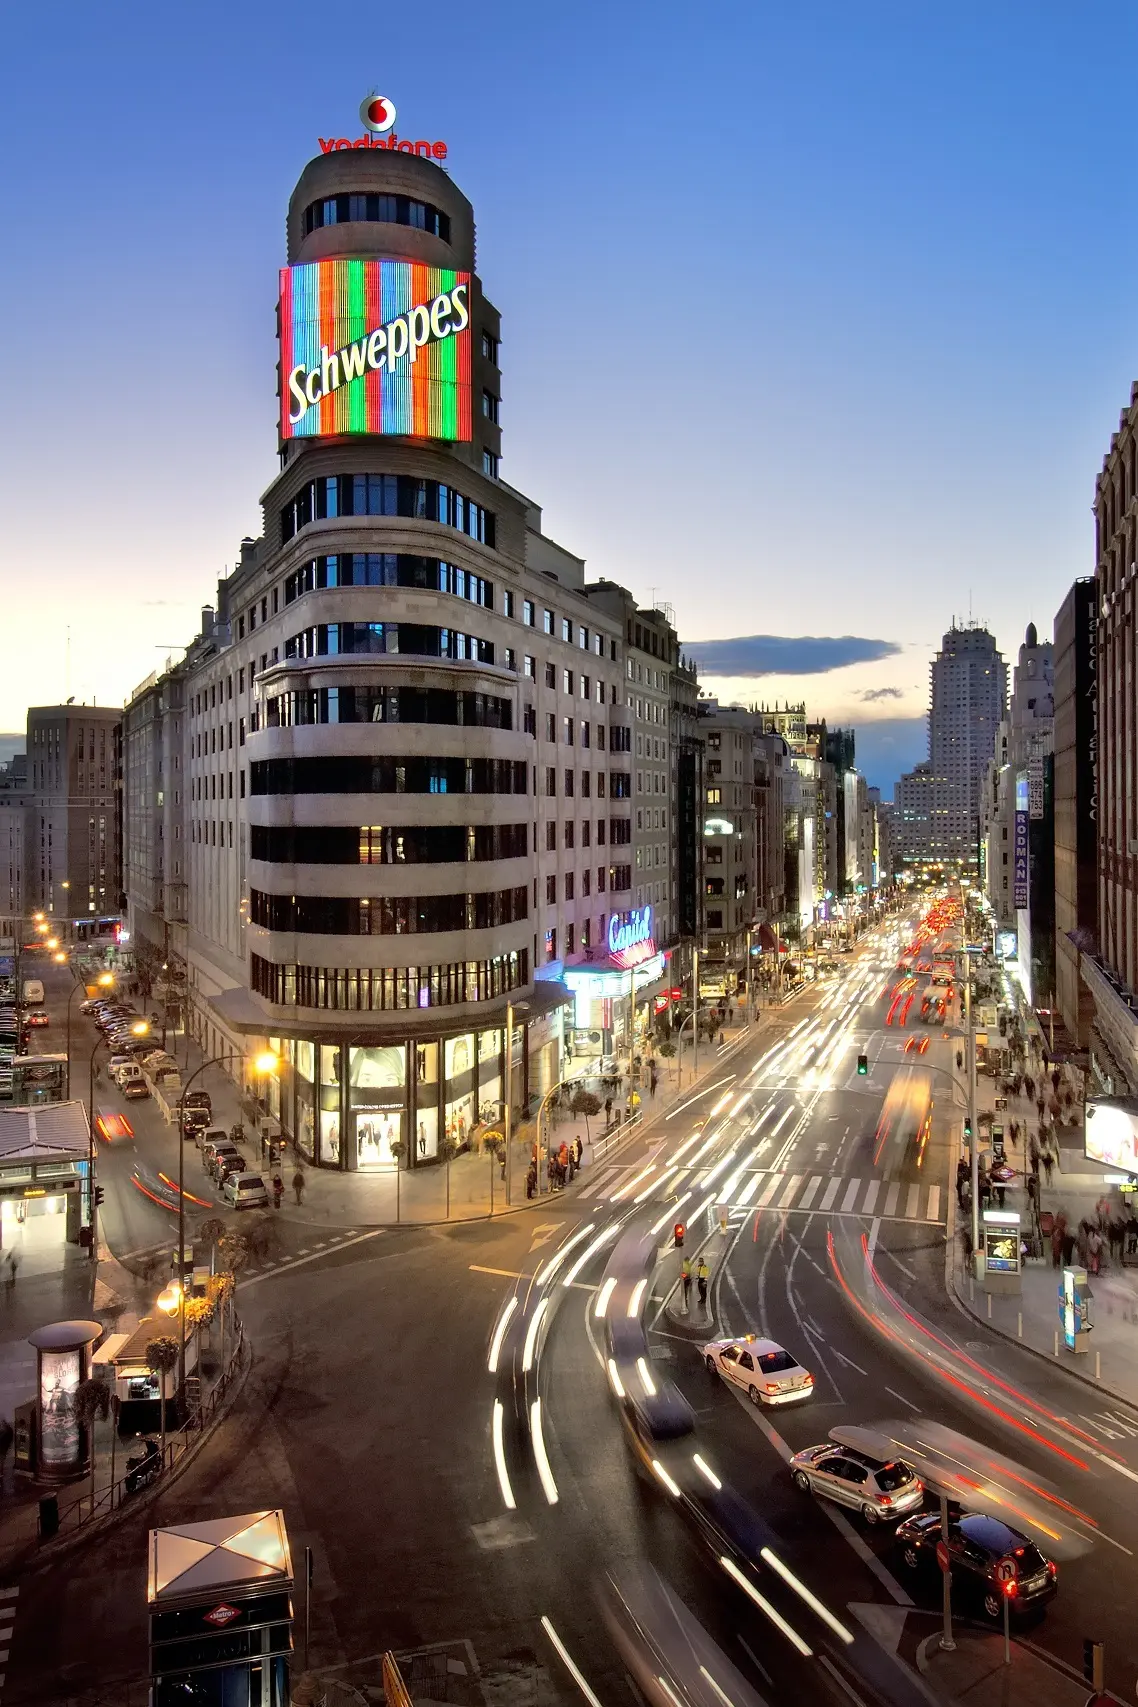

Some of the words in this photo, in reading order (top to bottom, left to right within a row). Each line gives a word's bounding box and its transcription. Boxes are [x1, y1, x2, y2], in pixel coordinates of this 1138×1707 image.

[288, 283, 470, 425] Schweppes
[1016, 814, 1027, 879] RODMAN
[609, 905, 651, 953] Capitol
[213, 1611, 232, 1619] Metro
